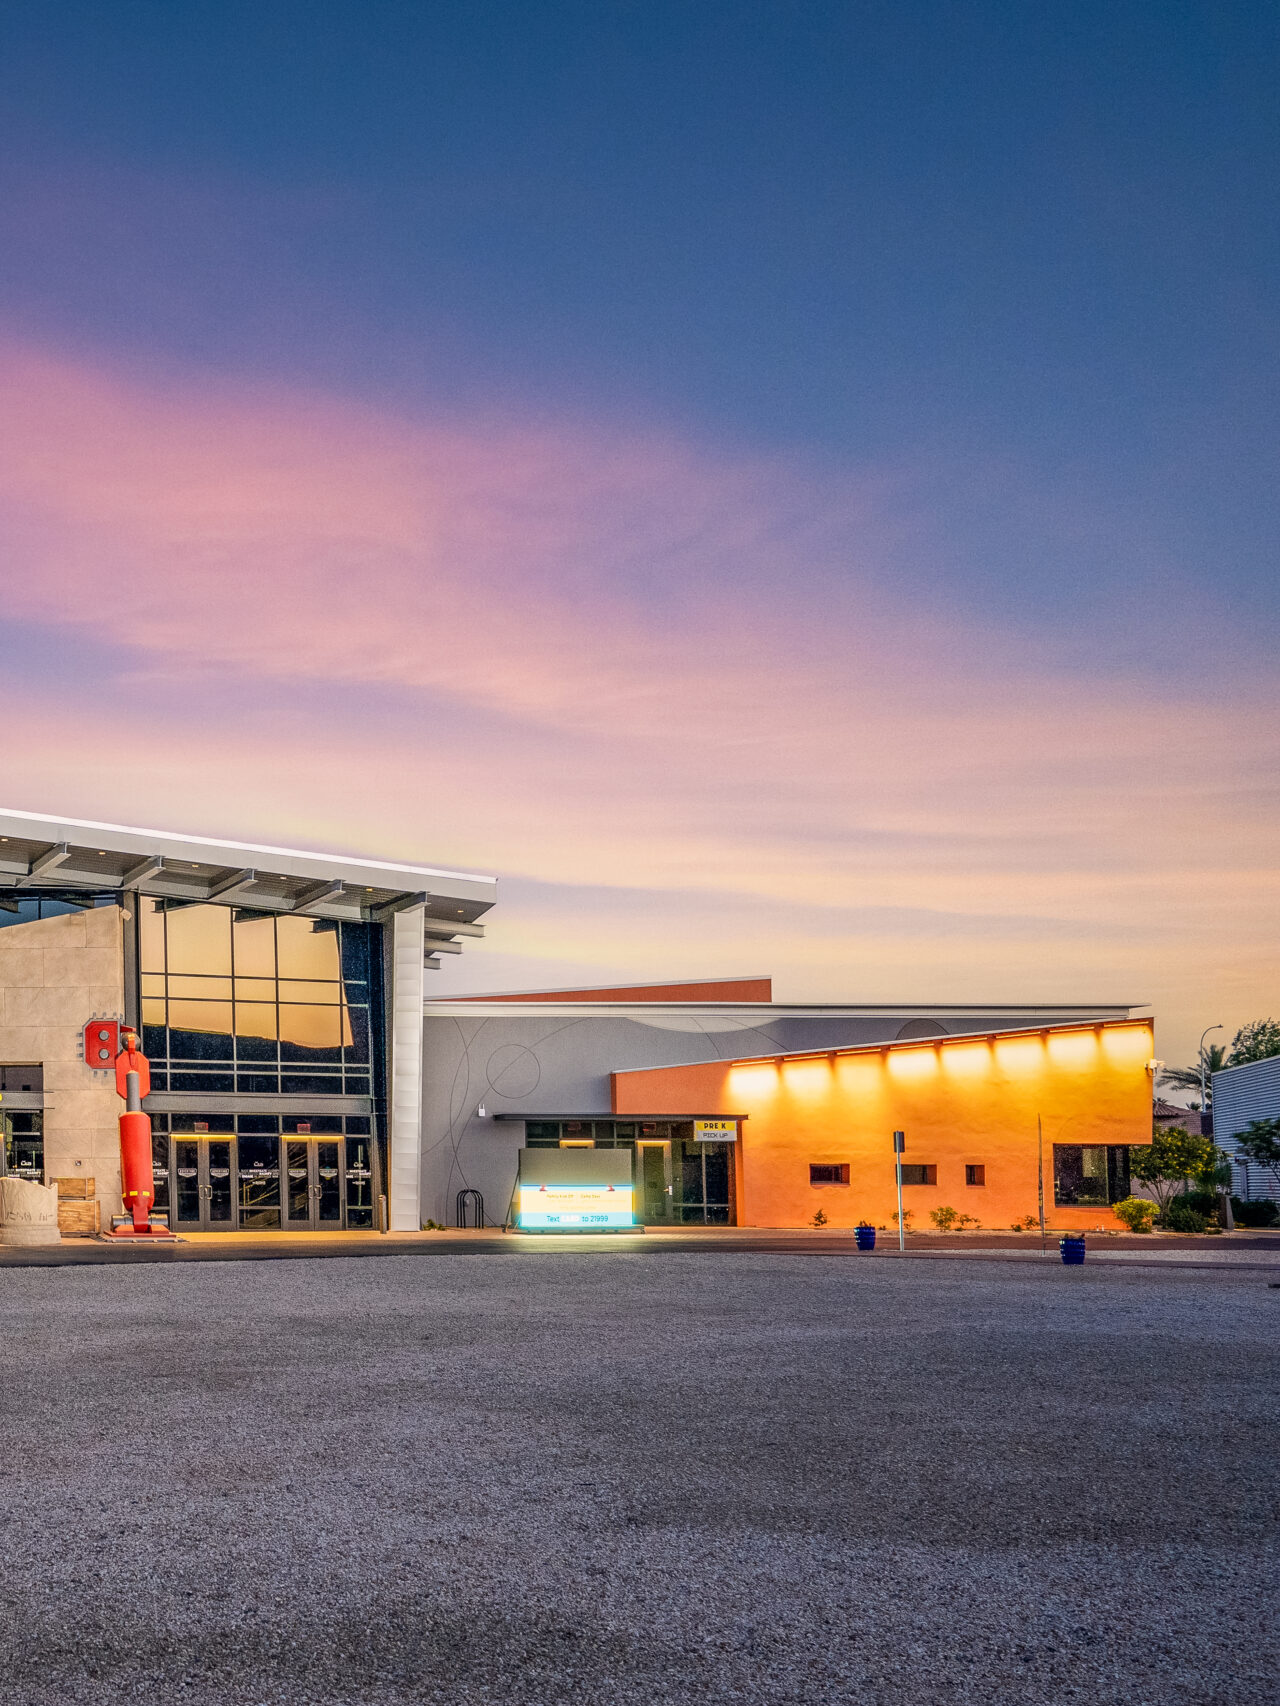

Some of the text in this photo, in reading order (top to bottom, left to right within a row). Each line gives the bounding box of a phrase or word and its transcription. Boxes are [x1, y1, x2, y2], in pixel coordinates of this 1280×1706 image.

[704, 1122, 726, 1130] PRE K
[546, 1215, 560, 1223] Text
